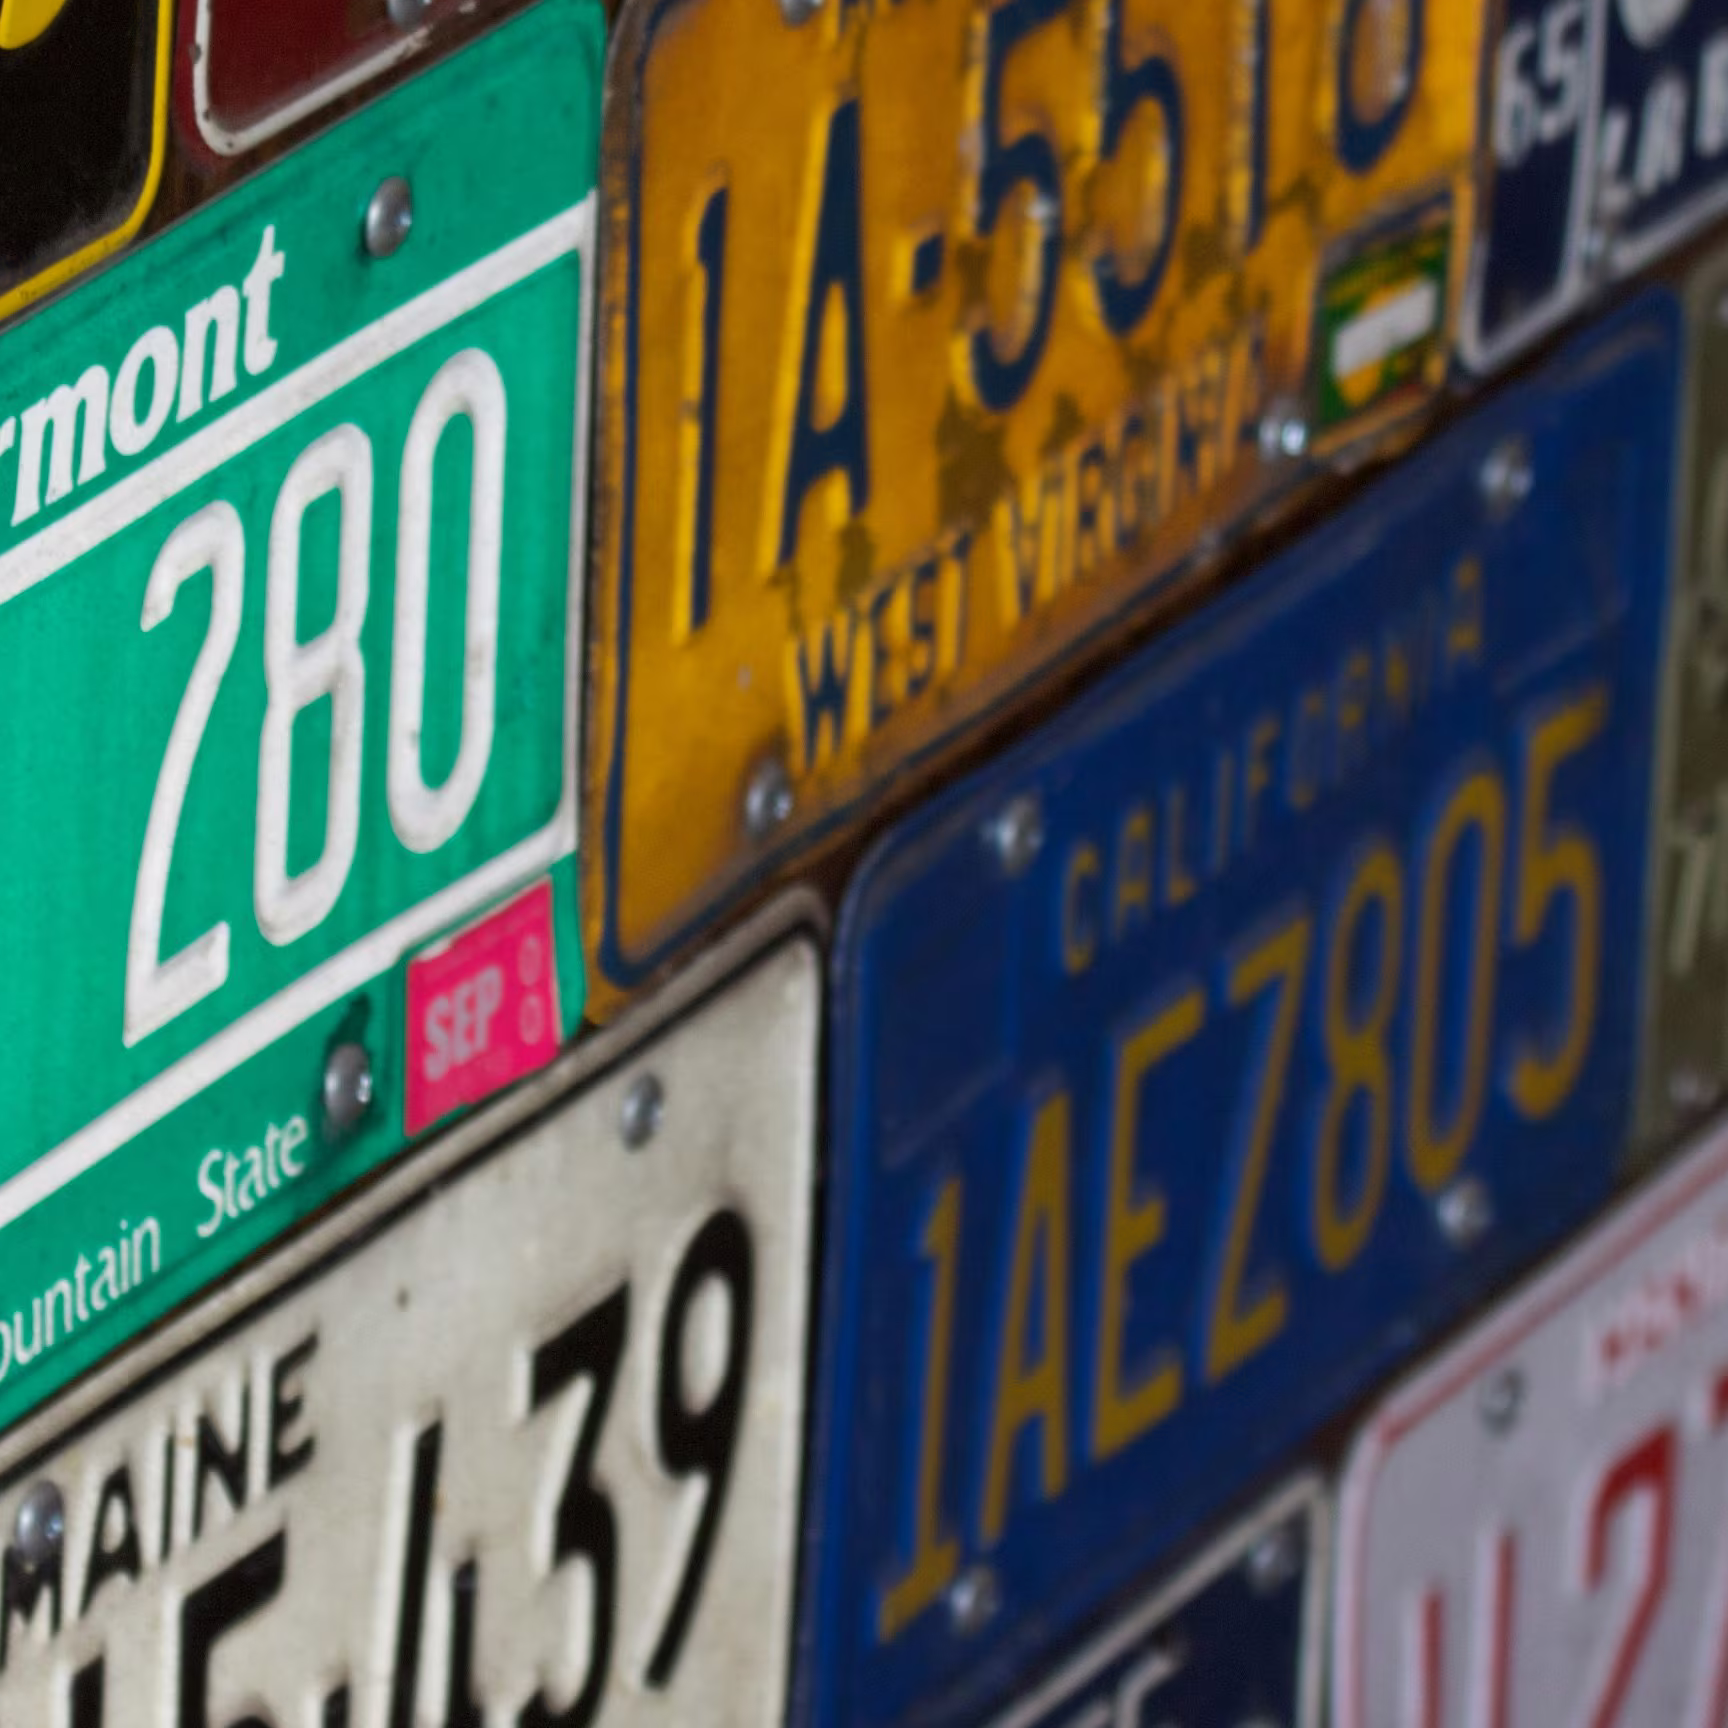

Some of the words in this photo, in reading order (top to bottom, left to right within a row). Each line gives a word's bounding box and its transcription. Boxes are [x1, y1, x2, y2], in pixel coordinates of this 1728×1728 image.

[122, 347, 508, 1049] 280
[1062, 556, 1486, 978] CALIFORNIA
[423, 964, 504, 1082] SEP
[195, 1113, 307, 1239] State
